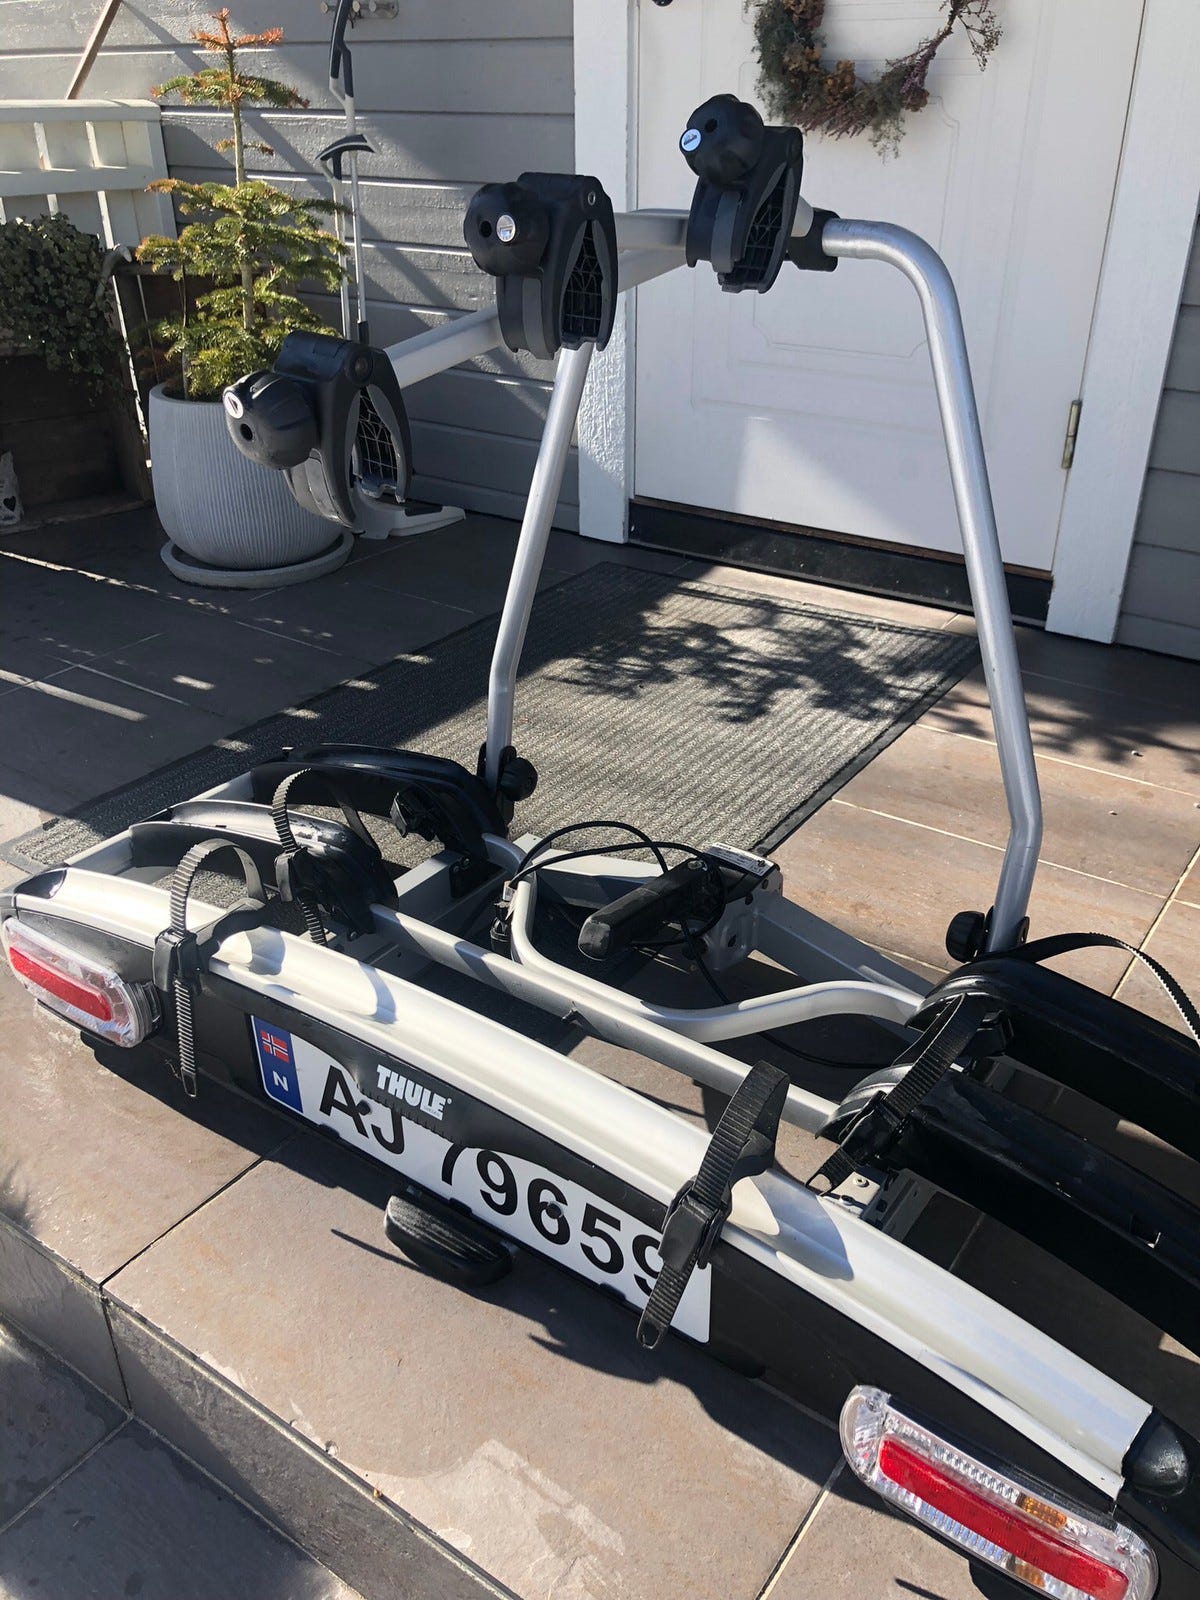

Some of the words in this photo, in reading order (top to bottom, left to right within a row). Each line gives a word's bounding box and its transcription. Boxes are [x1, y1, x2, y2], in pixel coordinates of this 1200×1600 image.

[272, 1070, 289, 1092] N
[377, 1064, 446, 1120] THULE
[319, 1065, 405, 1155] AJ
